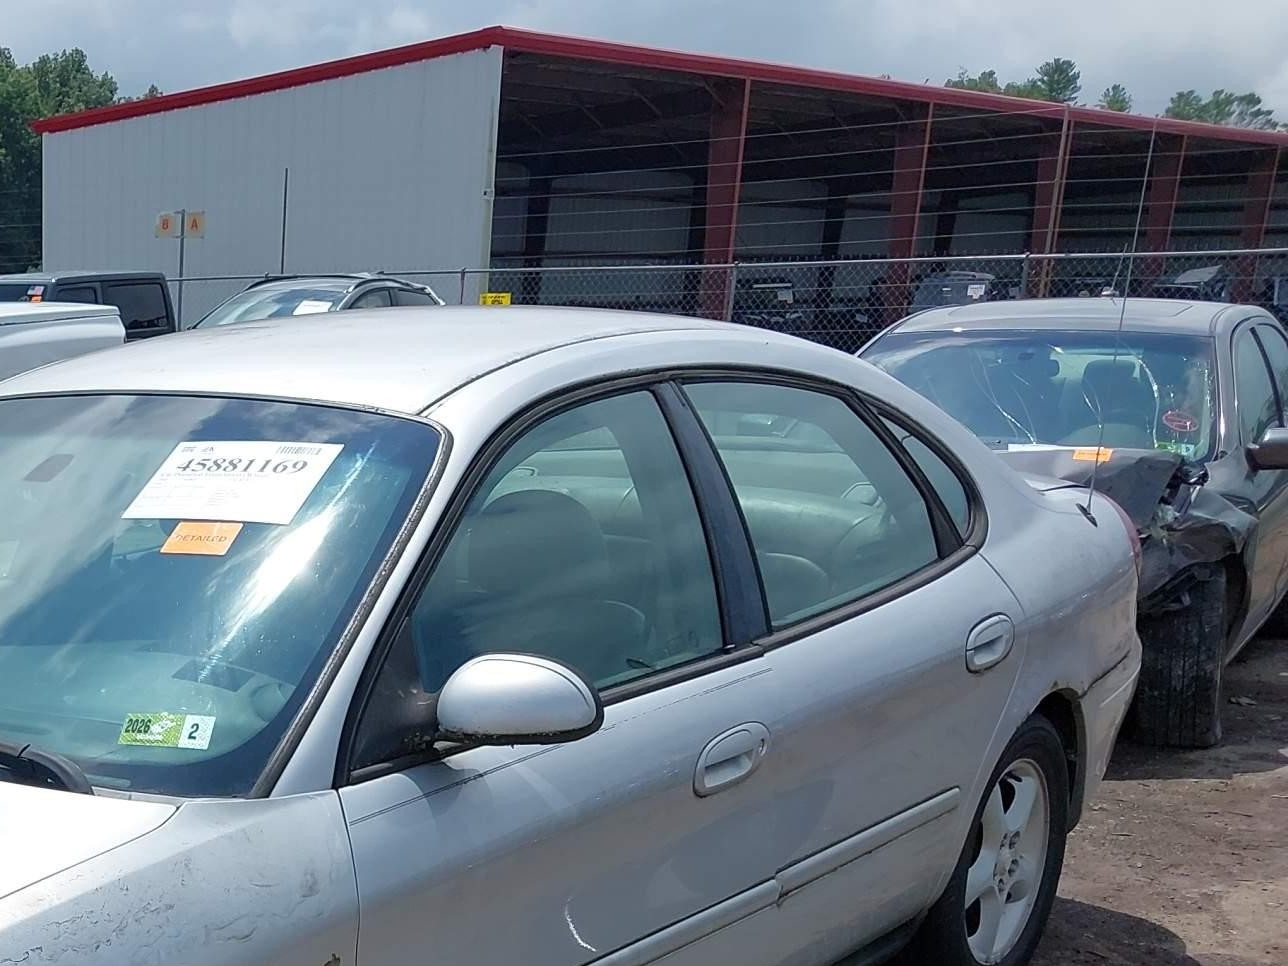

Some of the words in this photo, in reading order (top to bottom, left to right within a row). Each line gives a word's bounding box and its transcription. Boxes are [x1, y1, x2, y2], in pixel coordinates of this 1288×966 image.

[177, 457, 309, 475] 45881169
[175, 533, 229, 544] DETAILED
[124, 718, 152, 734] 2026
[187, 722, 200, 740] 2
